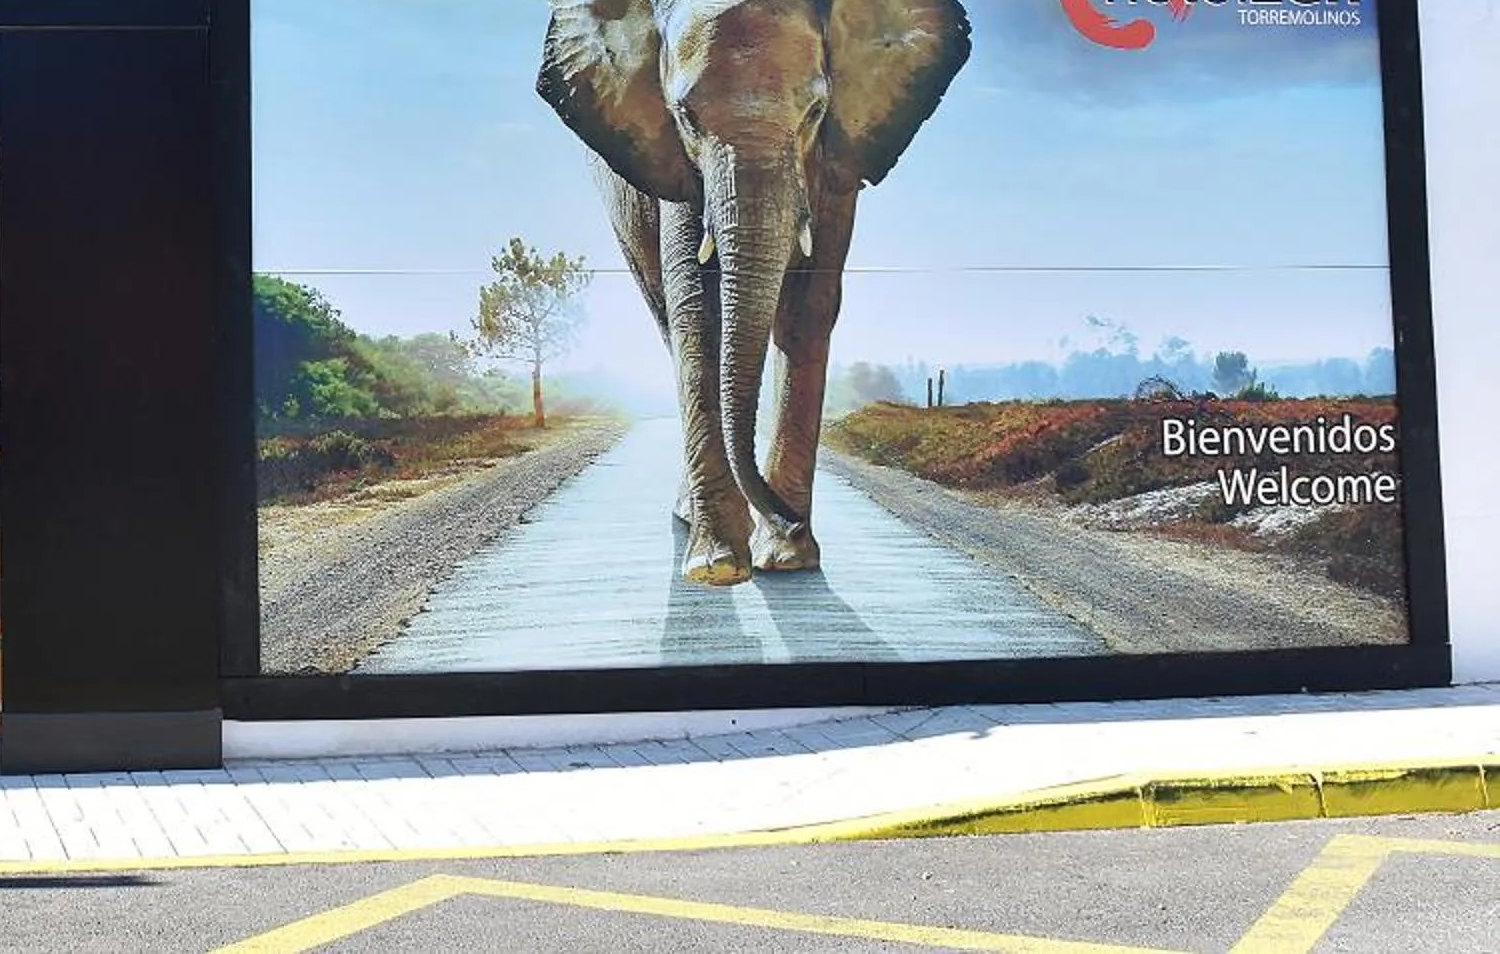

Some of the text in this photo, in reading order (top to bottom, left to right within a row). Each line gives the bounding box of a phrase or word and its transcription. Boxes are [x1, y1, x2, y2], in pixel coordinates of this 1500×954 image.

[1238, 9, 1361, 26] TORREMOLINOS
[1162, 415, 1396, 456] Bienvenidos
[1217, 466, 1397, 506] Welcome
